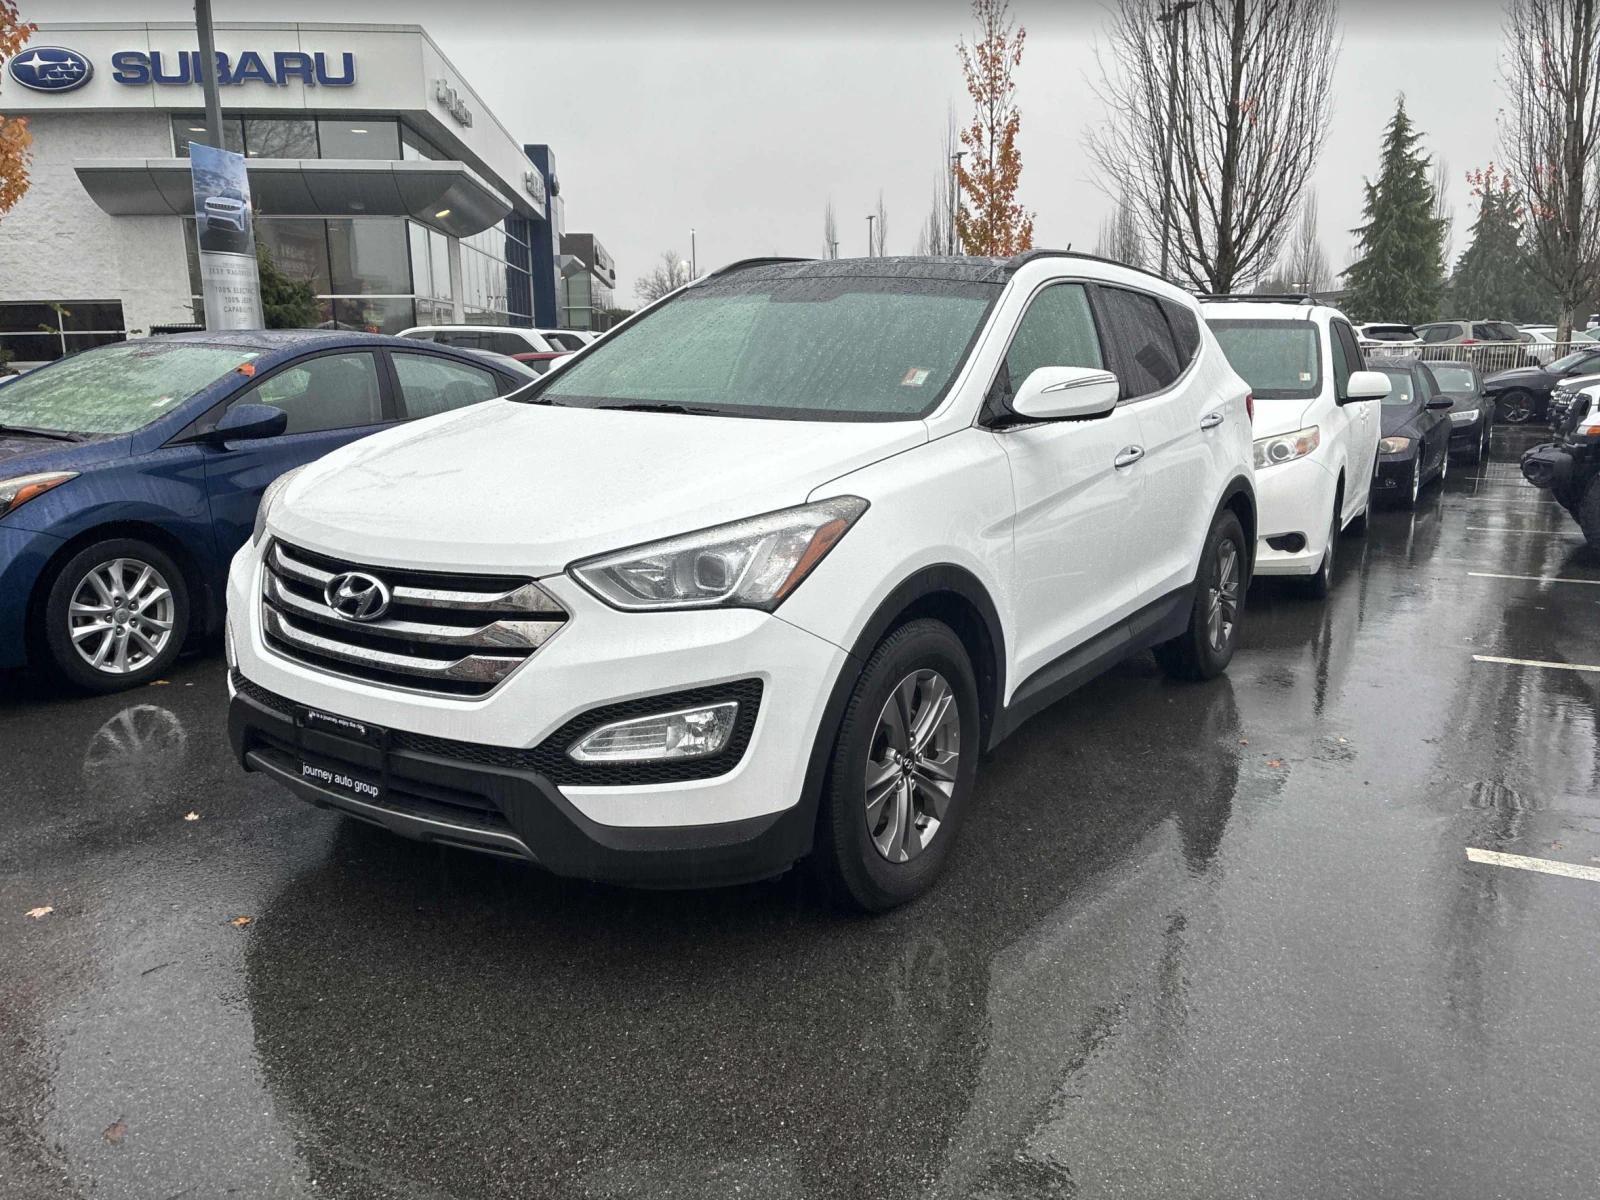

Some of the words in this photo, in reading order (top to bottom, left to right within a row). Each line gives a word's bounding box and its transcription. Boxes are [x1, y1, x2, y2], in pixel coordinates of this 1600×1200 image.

[111, 50, 355, 86] SUBARU
[214, 286, 232, 294] 100%
[224, 296, 240, 304] 100%
[302, 762, 333, 783] journey
[334, 774, 353, 787] auto
[354, 780, 379, 798] group
